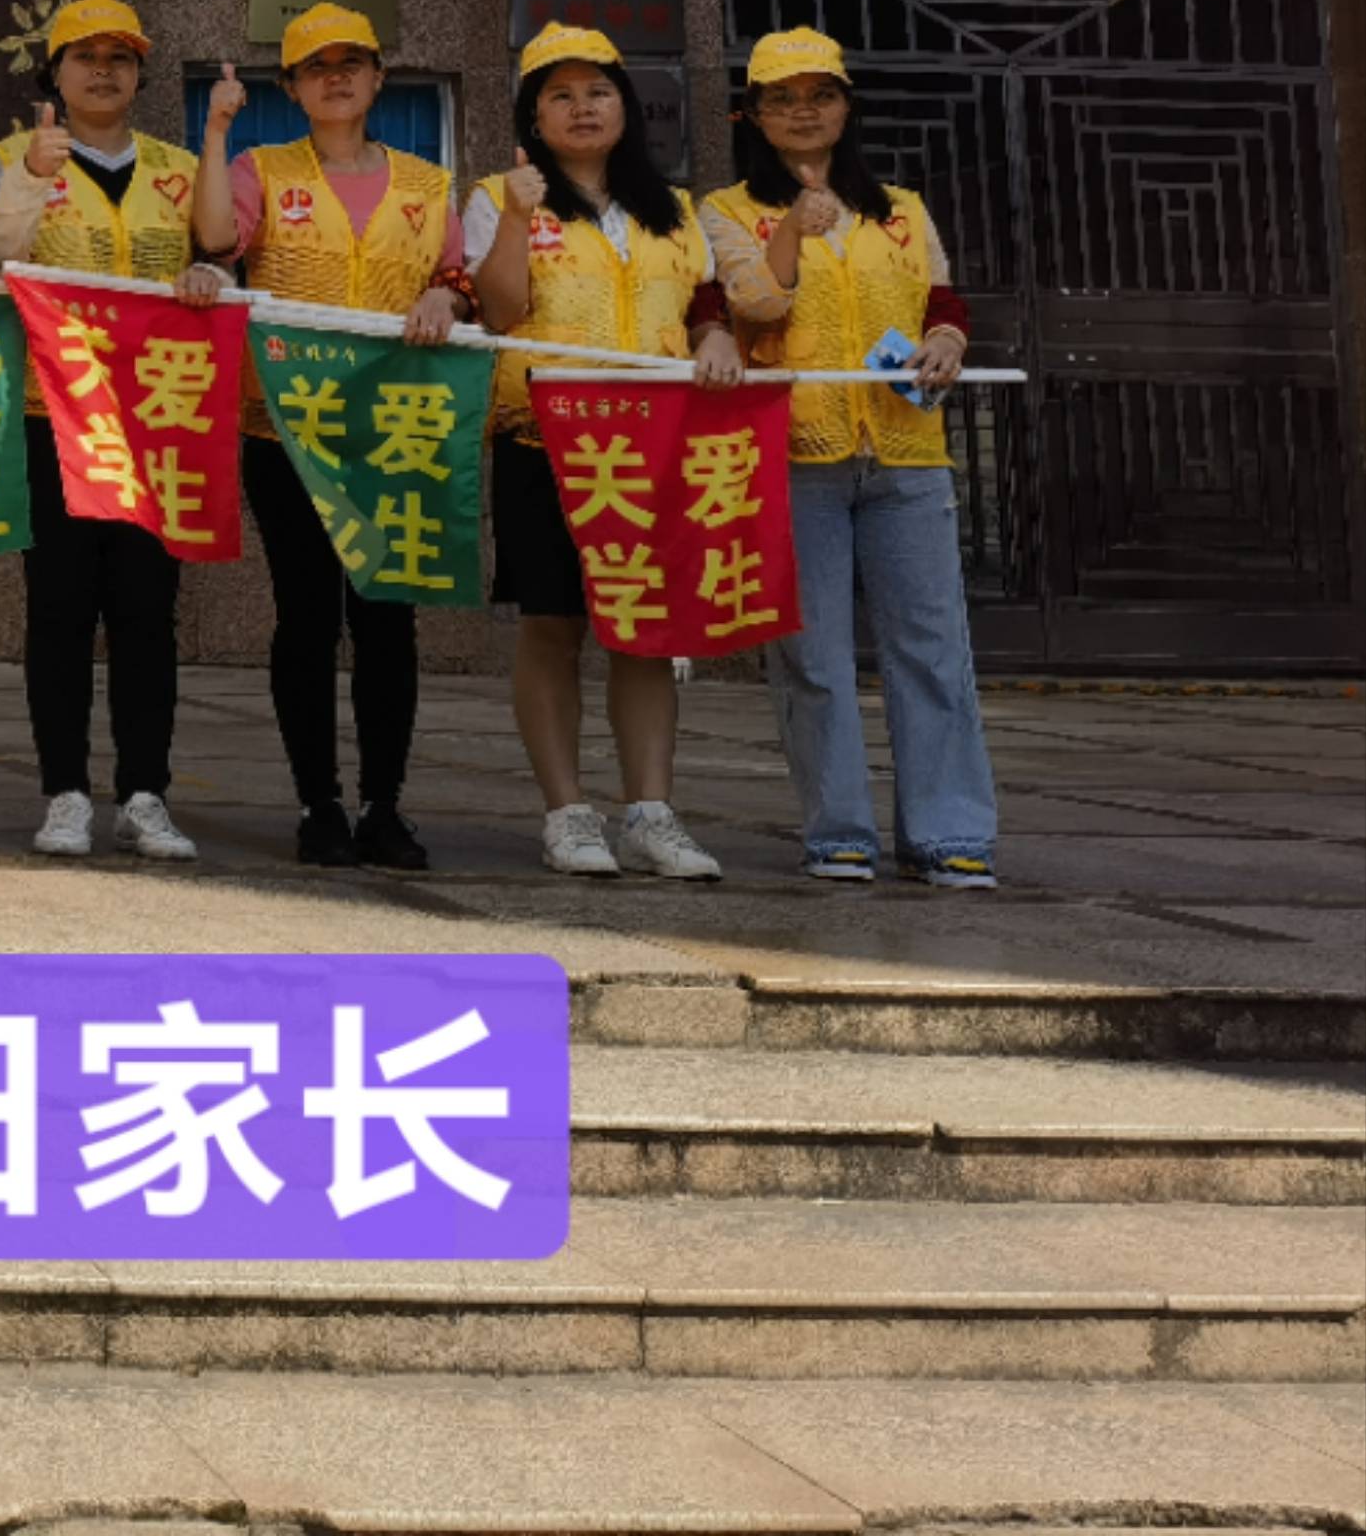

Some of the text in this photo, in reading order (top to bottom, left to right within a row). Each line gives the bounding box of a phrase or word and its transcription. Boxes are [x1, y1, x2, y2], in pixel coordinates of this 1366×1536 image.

[57, 314, 217, 434] 关爱
[278, 373, 457, 481] 关爱
[77, 410, 216, 544] 学生
[563, 427, 763, 530] 关爱
[581, 536, 779, 641] 学生
